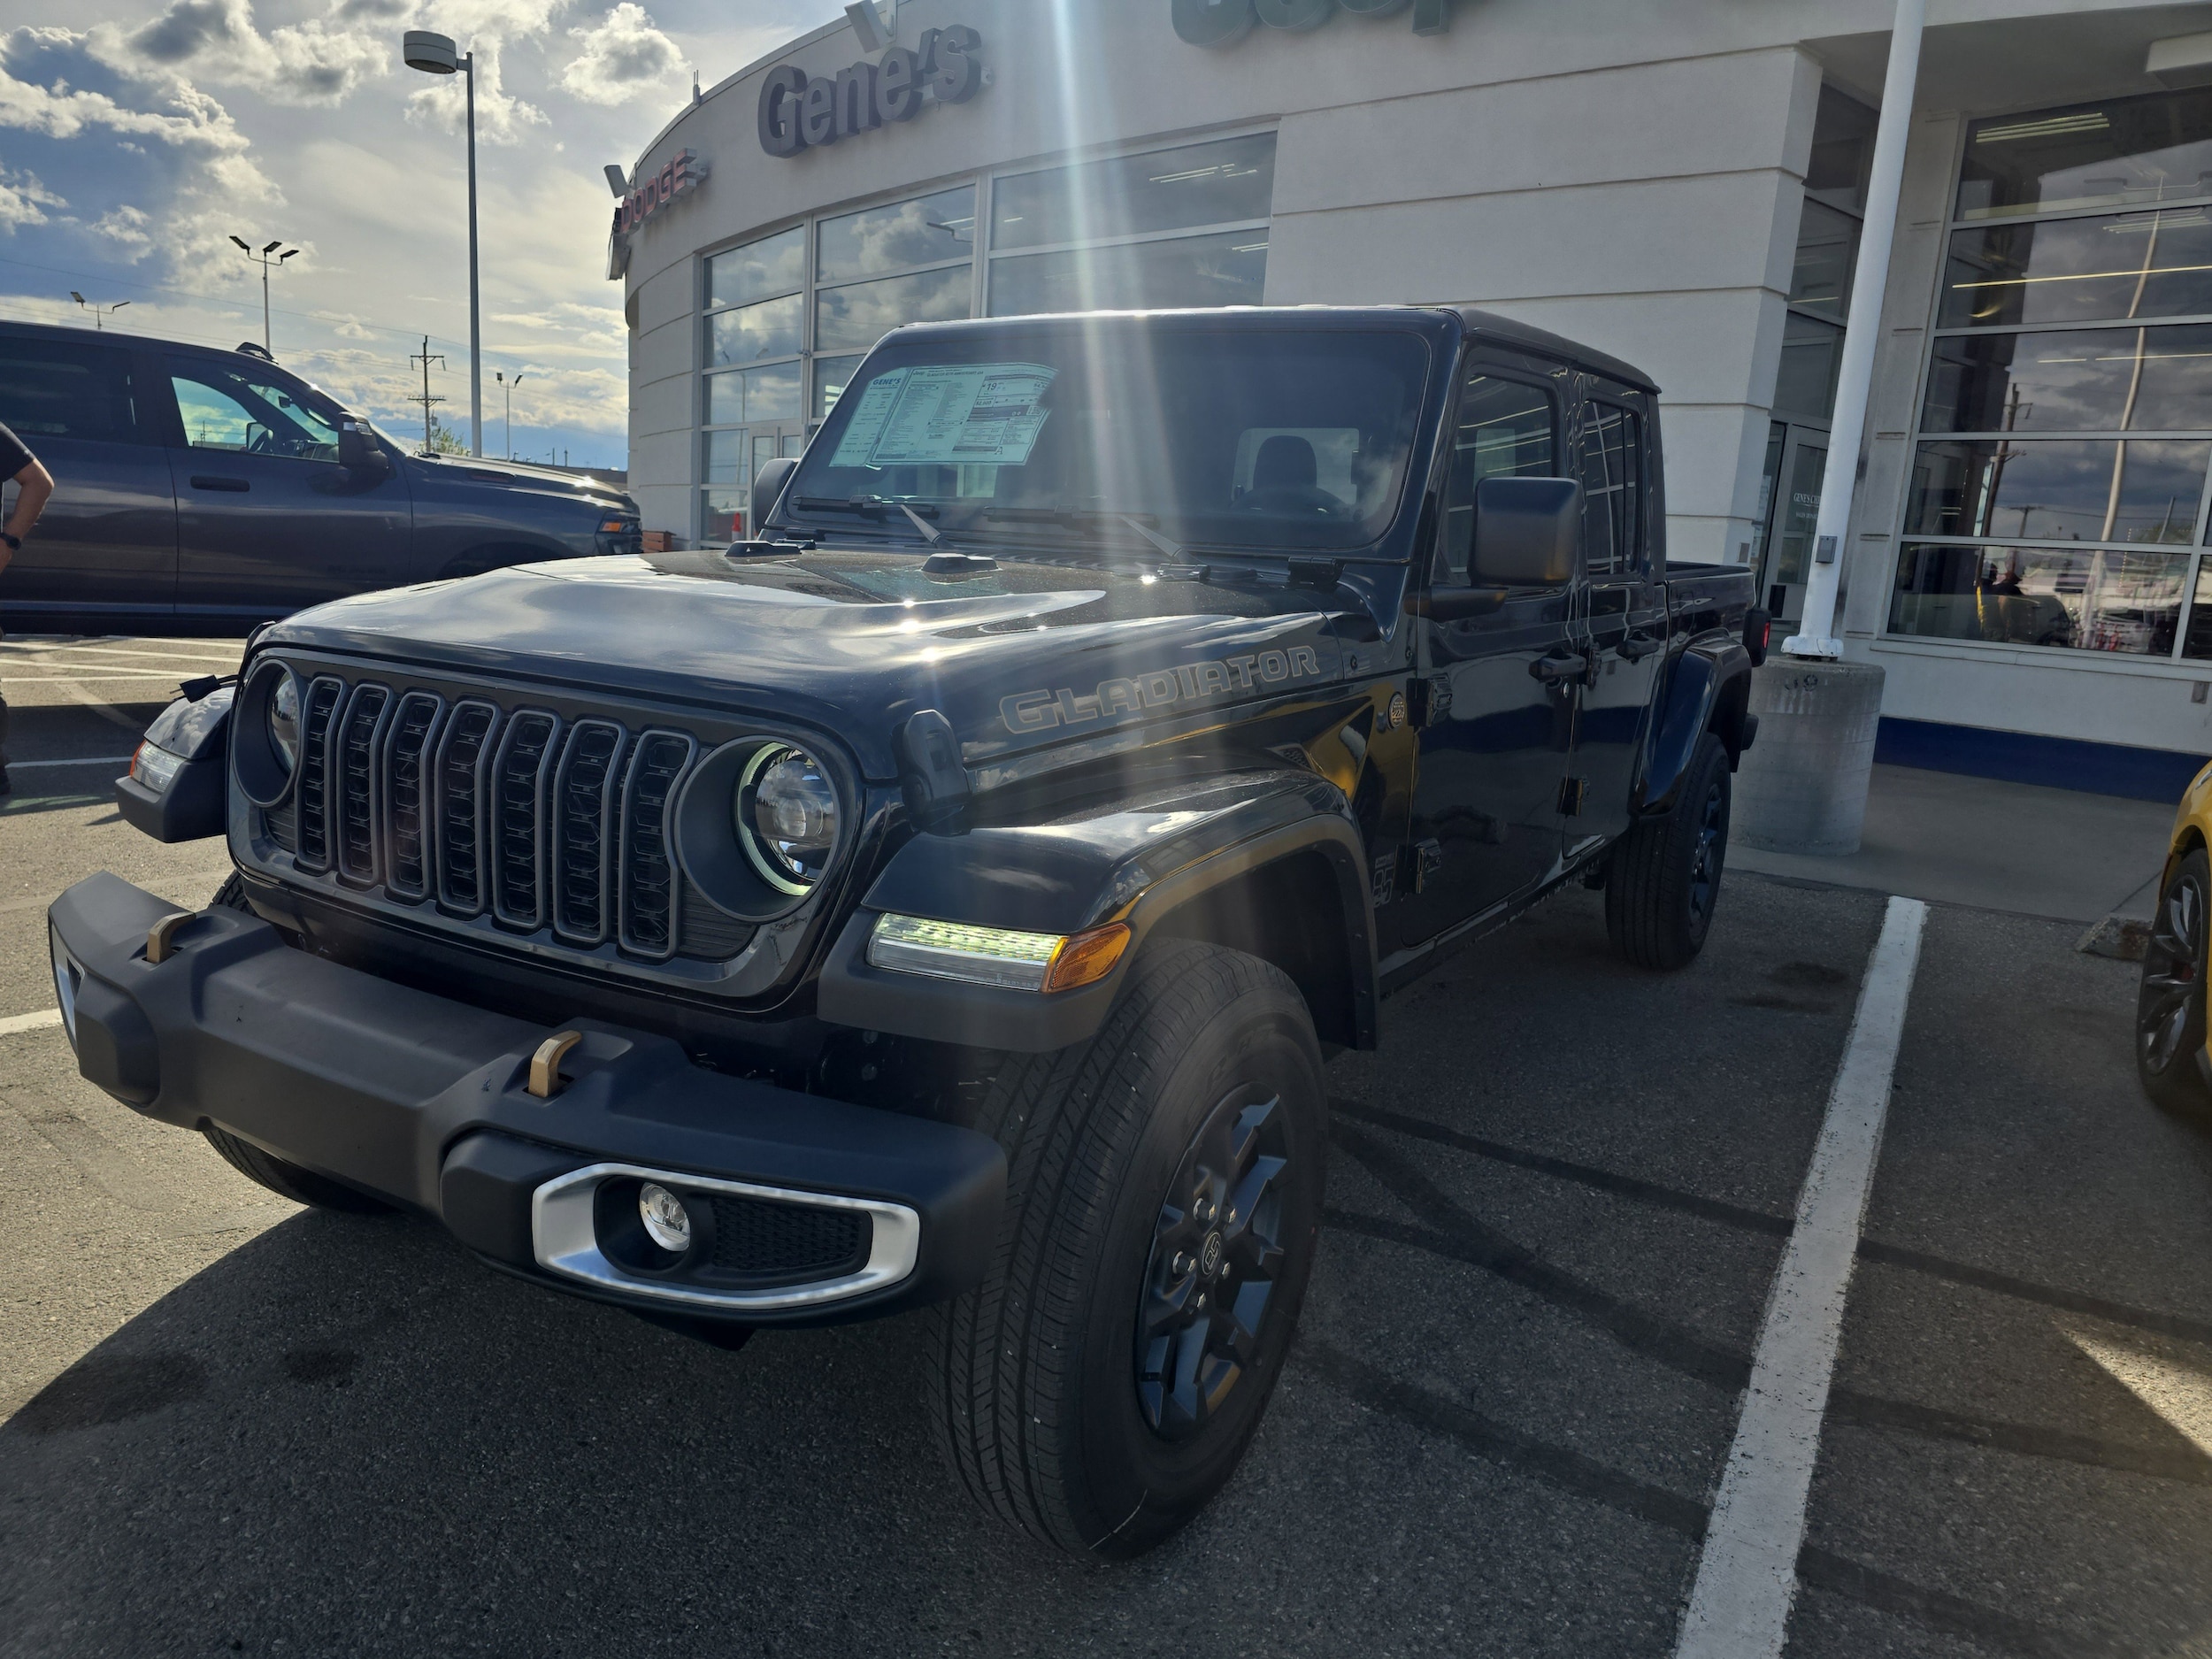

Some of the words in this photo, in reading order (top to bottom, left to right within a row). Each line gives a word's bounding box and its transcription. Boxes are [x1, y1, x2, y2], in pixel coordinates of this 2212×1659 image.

[757, 24, 982, 158] Gene's
[621, 148, 697, 235] DODGE
[987, 382, 997, 391] 19
[999, 644, 1321, 735] GLADIATOR
